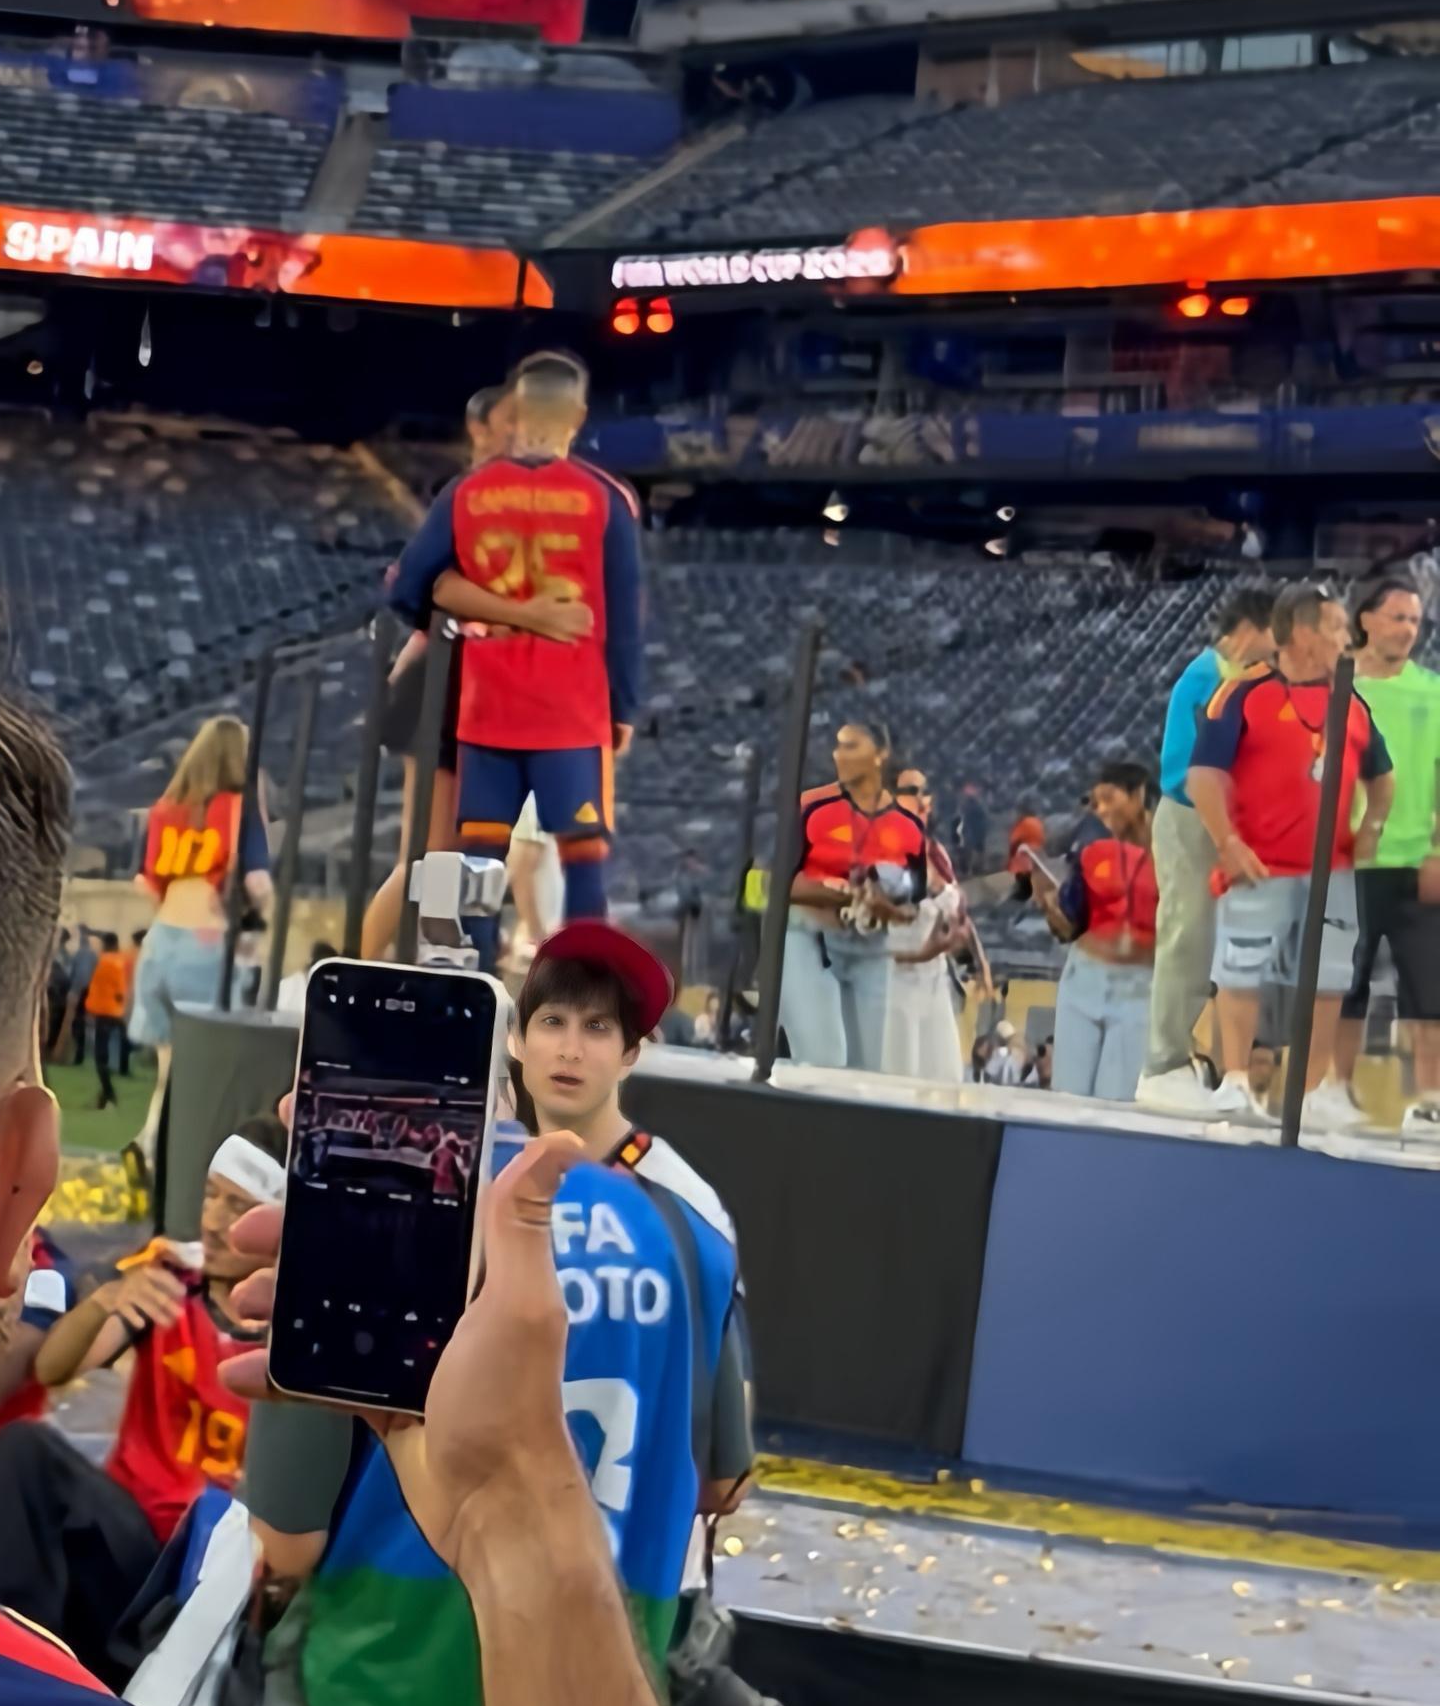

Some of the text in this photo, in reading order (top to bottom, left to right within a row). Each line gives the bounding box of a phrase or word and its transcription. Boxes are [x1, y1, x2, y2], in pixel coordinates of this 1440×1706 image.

[4, 221, 155, 272] SPAIN
[553, 1202, 635, 1254] FA
[558, 1266, 671, 1324] OTO
[176, 1400, 244, 1476] 19
